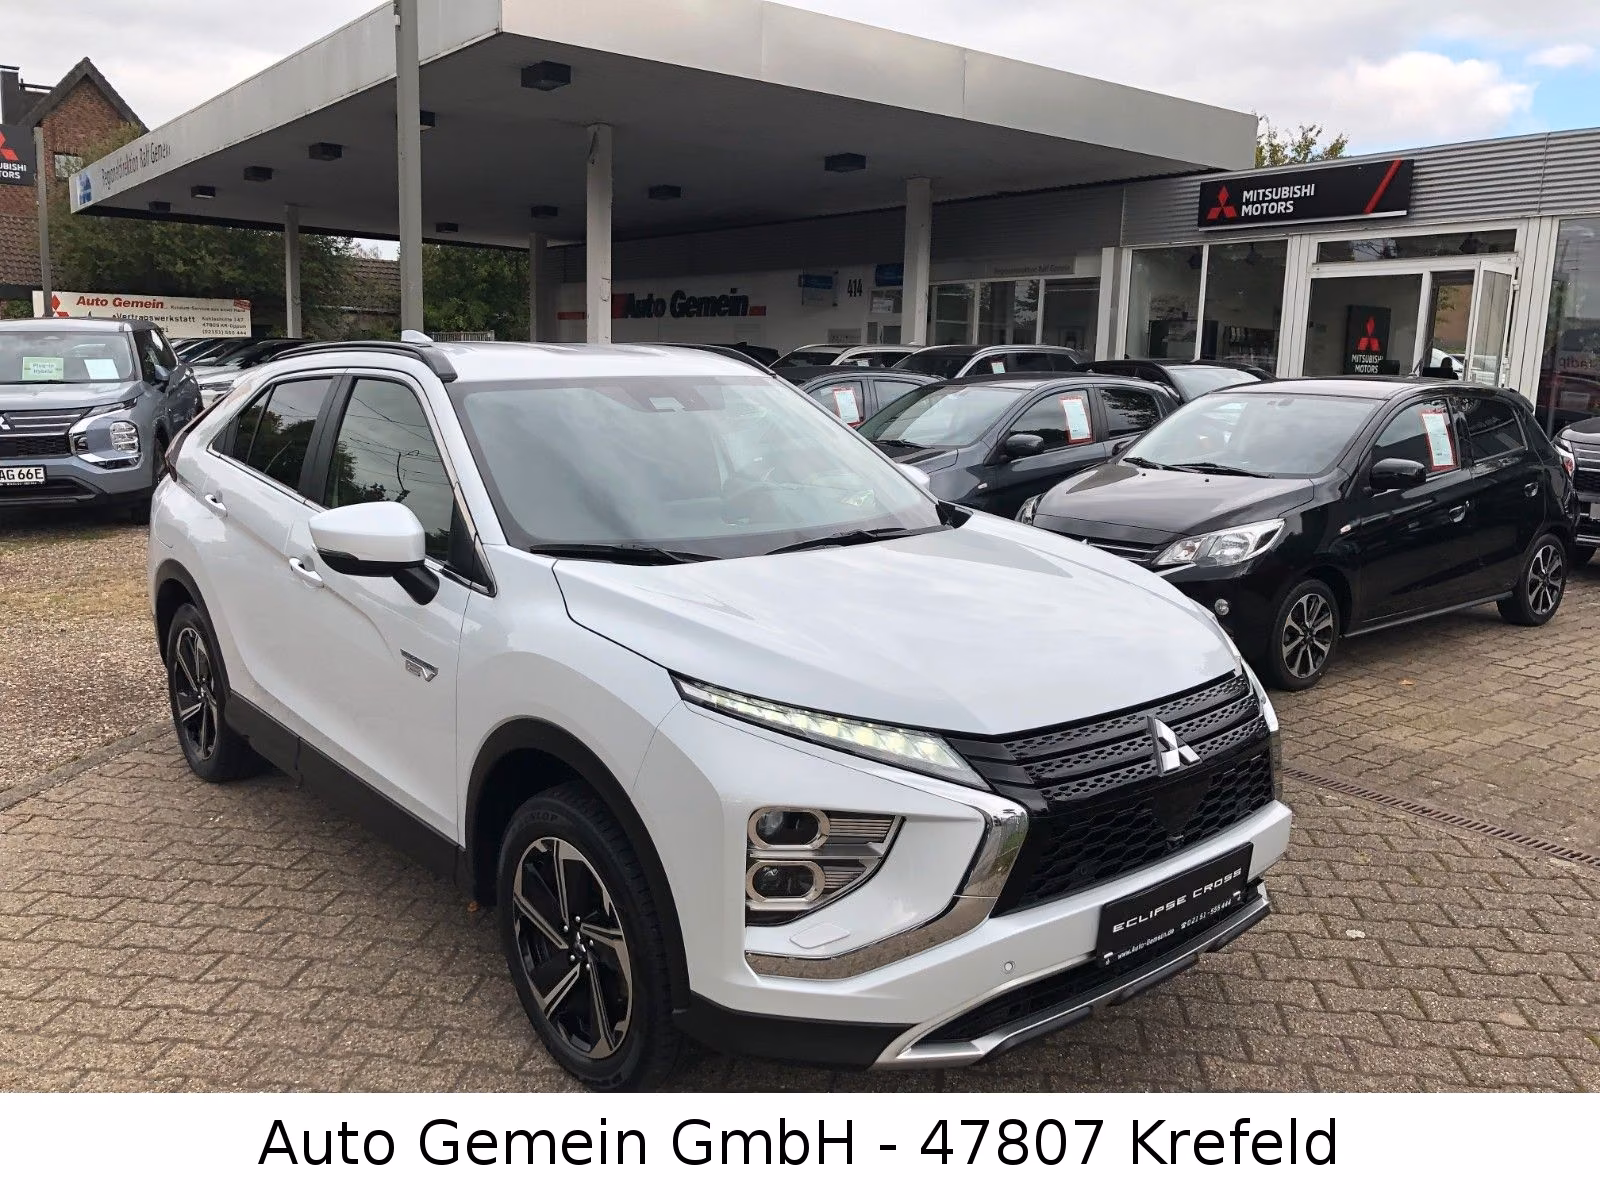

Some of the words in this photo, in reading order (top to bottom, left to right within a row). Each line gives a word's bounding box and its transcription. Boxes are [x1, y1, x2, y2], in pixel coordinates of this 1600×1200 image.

[1242, 183, 1316, 203] MITSUBISHI
[1241, 200, 1294, 217] MOTORS
[847, 278, 863, 298] 414
[76, 296, 108, 307] Auto
[112, 297, 164, 309] Gemein
[624, 292, 667, 319] Auto
[669, 288, 749, 318] Gemein
[1354, 364, 1379, 374] MOTORS
[0, 469, 15, 481] AG
[18, 468, 44, 480] 66E
[1112, 894, 1187, 933] ECLIPSE
[1192, 867, 1242, 899] CROSS
